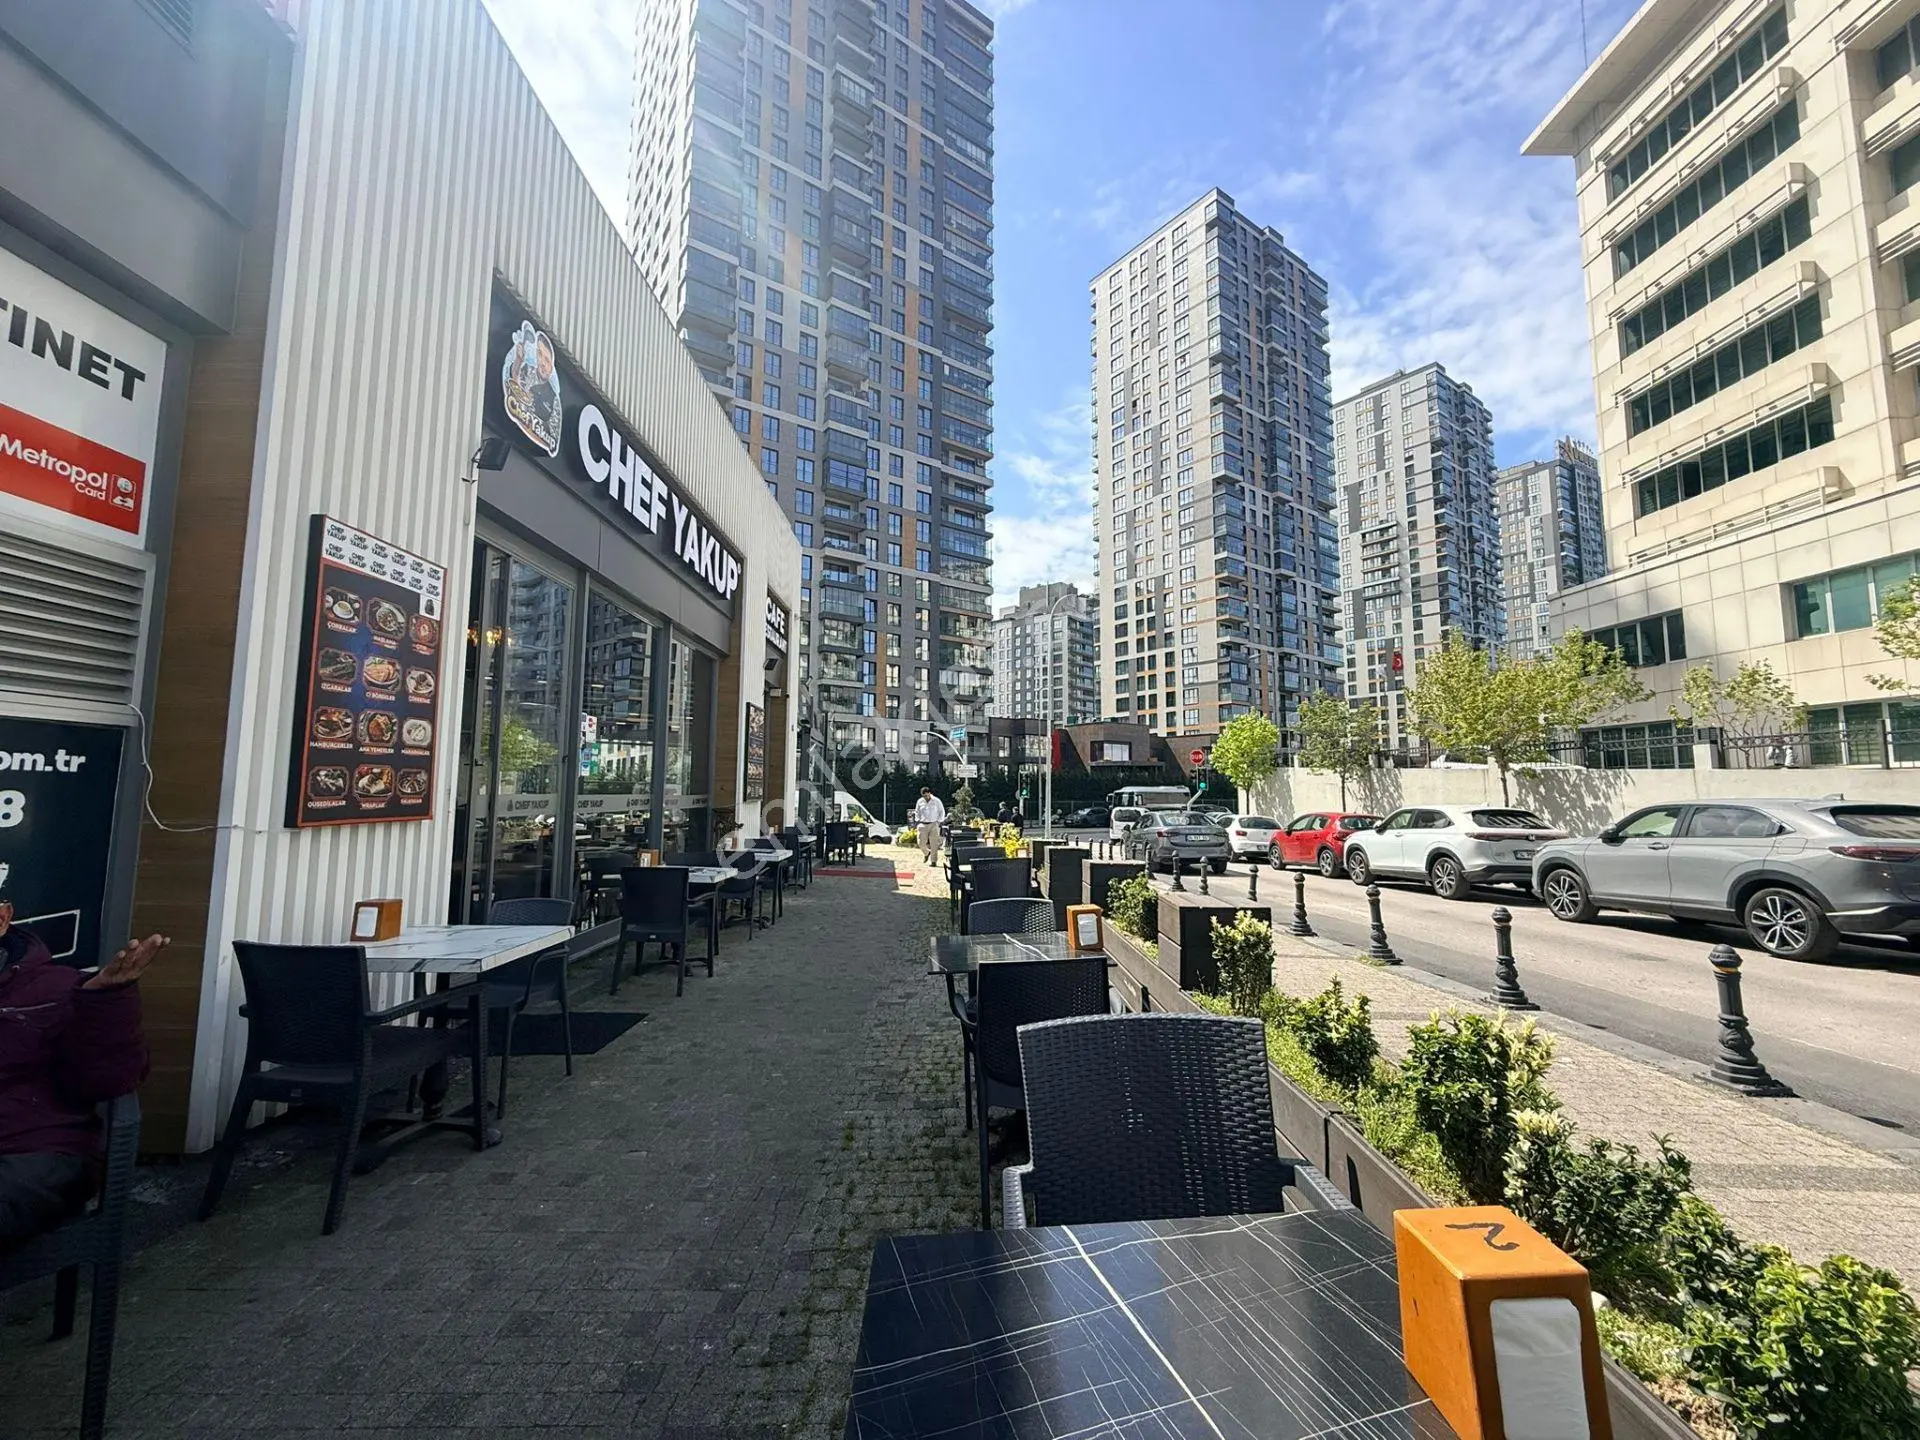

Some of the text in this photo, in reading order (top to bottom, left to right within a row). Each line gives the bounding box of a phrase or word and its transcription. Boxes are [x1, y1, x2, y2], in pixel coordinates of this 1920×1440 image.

[0, 433, 108, 490] Metropol
[75, 481, 106, 501] Card
[577, 404, 739, 601] CHEF YAKUP
[765, 597, 786, 635] CAFE
